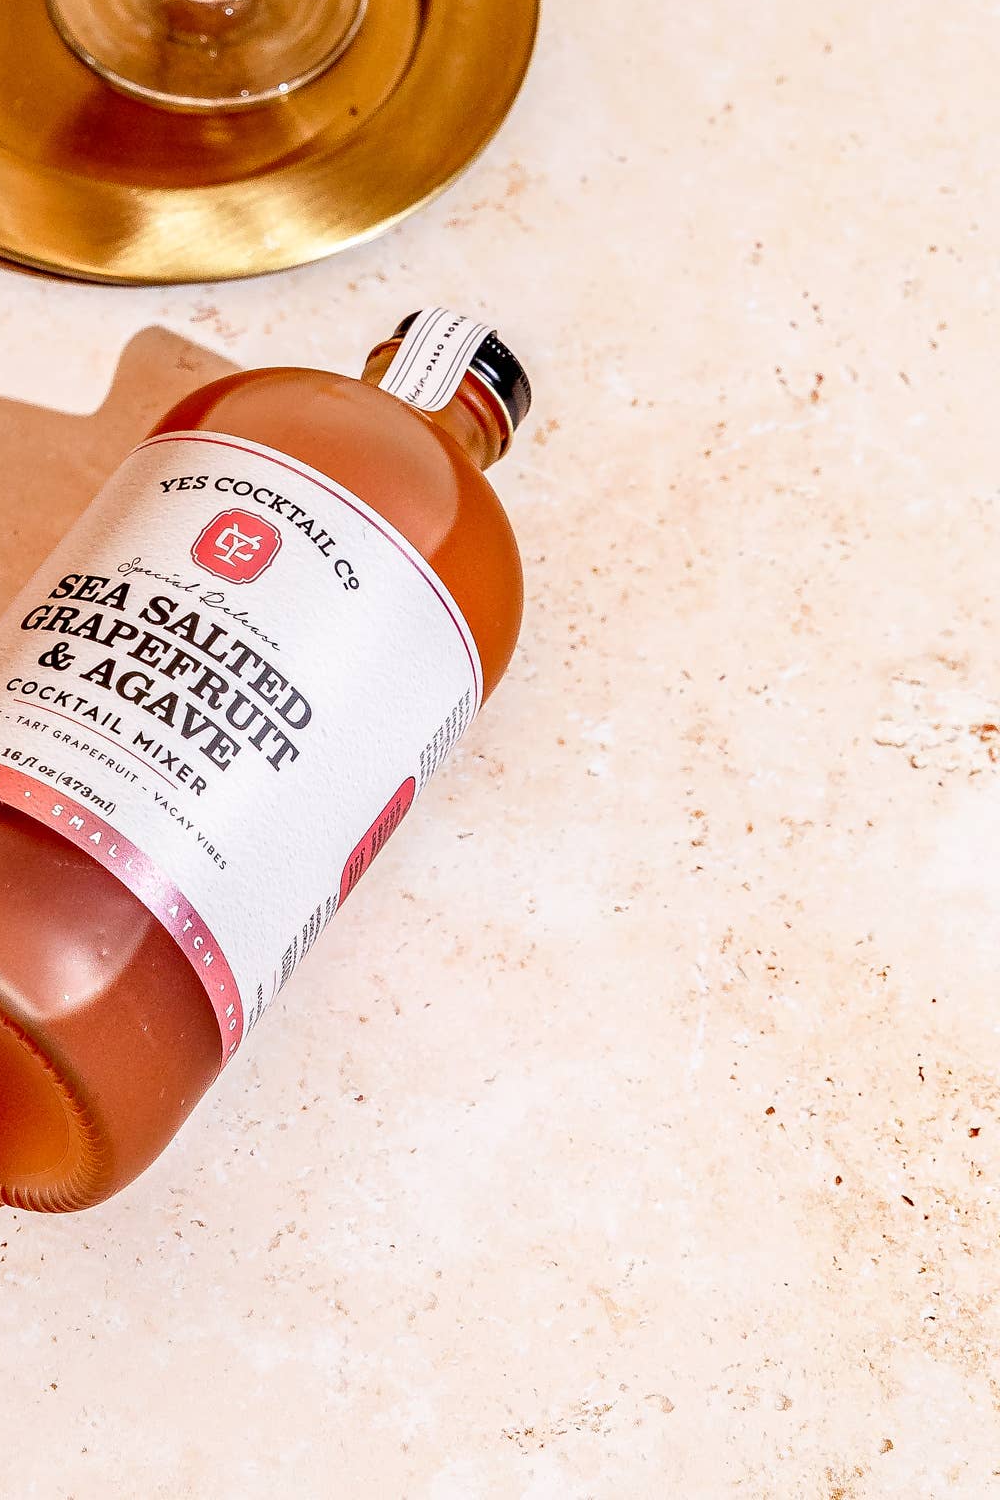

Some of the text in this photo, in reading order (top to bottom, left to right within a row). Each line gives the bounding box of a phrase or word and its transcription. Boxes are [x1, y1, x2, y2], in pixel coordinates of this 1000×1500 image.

[426, 344, 444, 372] PASO
[160, 475, 209, 493] YES
[214, 476, 336, 558] COCKTAIL
[48, 573, 312, 730] SEA SALTED
[118, 556, 281, 651] Special Release
[6, 678, 207, 796] COCKTAIL MIXER
[20, 604, 300, 772] GRAPEFRUIT
[38, 641, 242, 772] & AGAVE
[1, 747, 117, 817] 16 fl oz (473ml)
[16, 715, 49, 733] TART
[53, 730, 139, 783] GRAPEFRUIT
[154, 792, 194, 831] VACAY
[197, 832, 227, 870] VIBES
[51, 804, 134, 871] SMALL
[164, 900, 215, 967] ATCH
